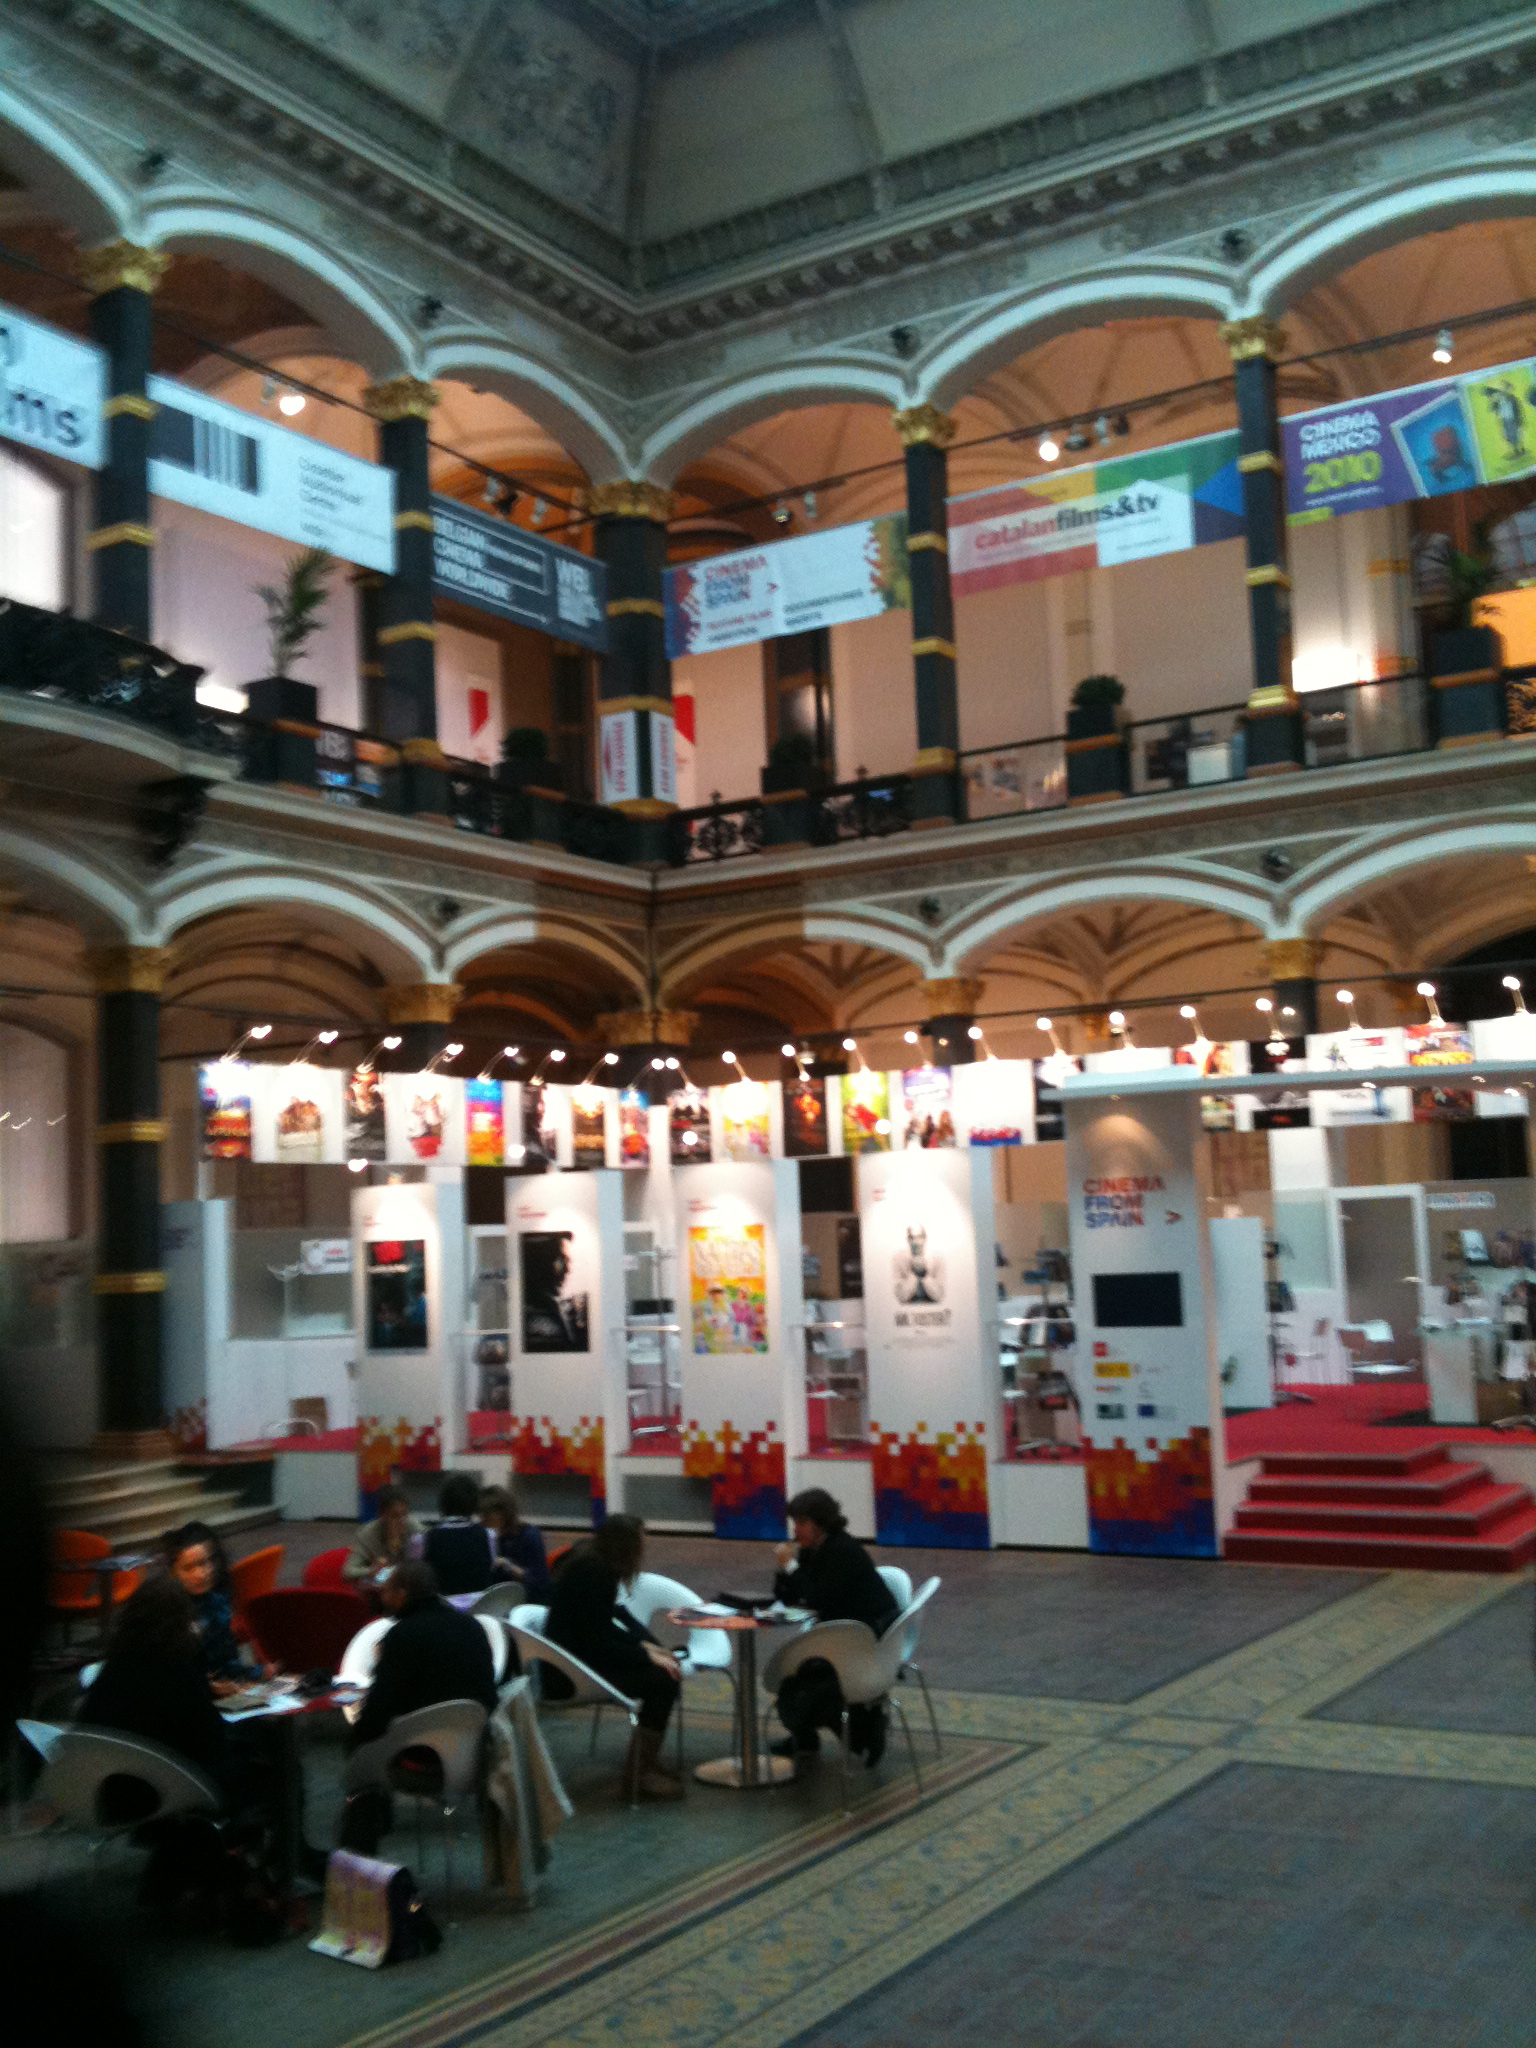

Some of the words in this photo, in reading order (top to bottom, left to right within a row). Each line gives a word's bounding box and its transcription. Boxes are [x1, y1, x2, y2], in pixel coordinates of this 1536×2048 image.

[2, 388, 85, 447] ms
[1300, 411, 1380, 440] CINEMA
[1303, 450, 1383, 494] 2010
[1083, 1175, 1166, 1194] CINEMA
[1084, 1193, 1143, 1210] FROM
[1085, 1210, 1145, 1229] SPAIN
